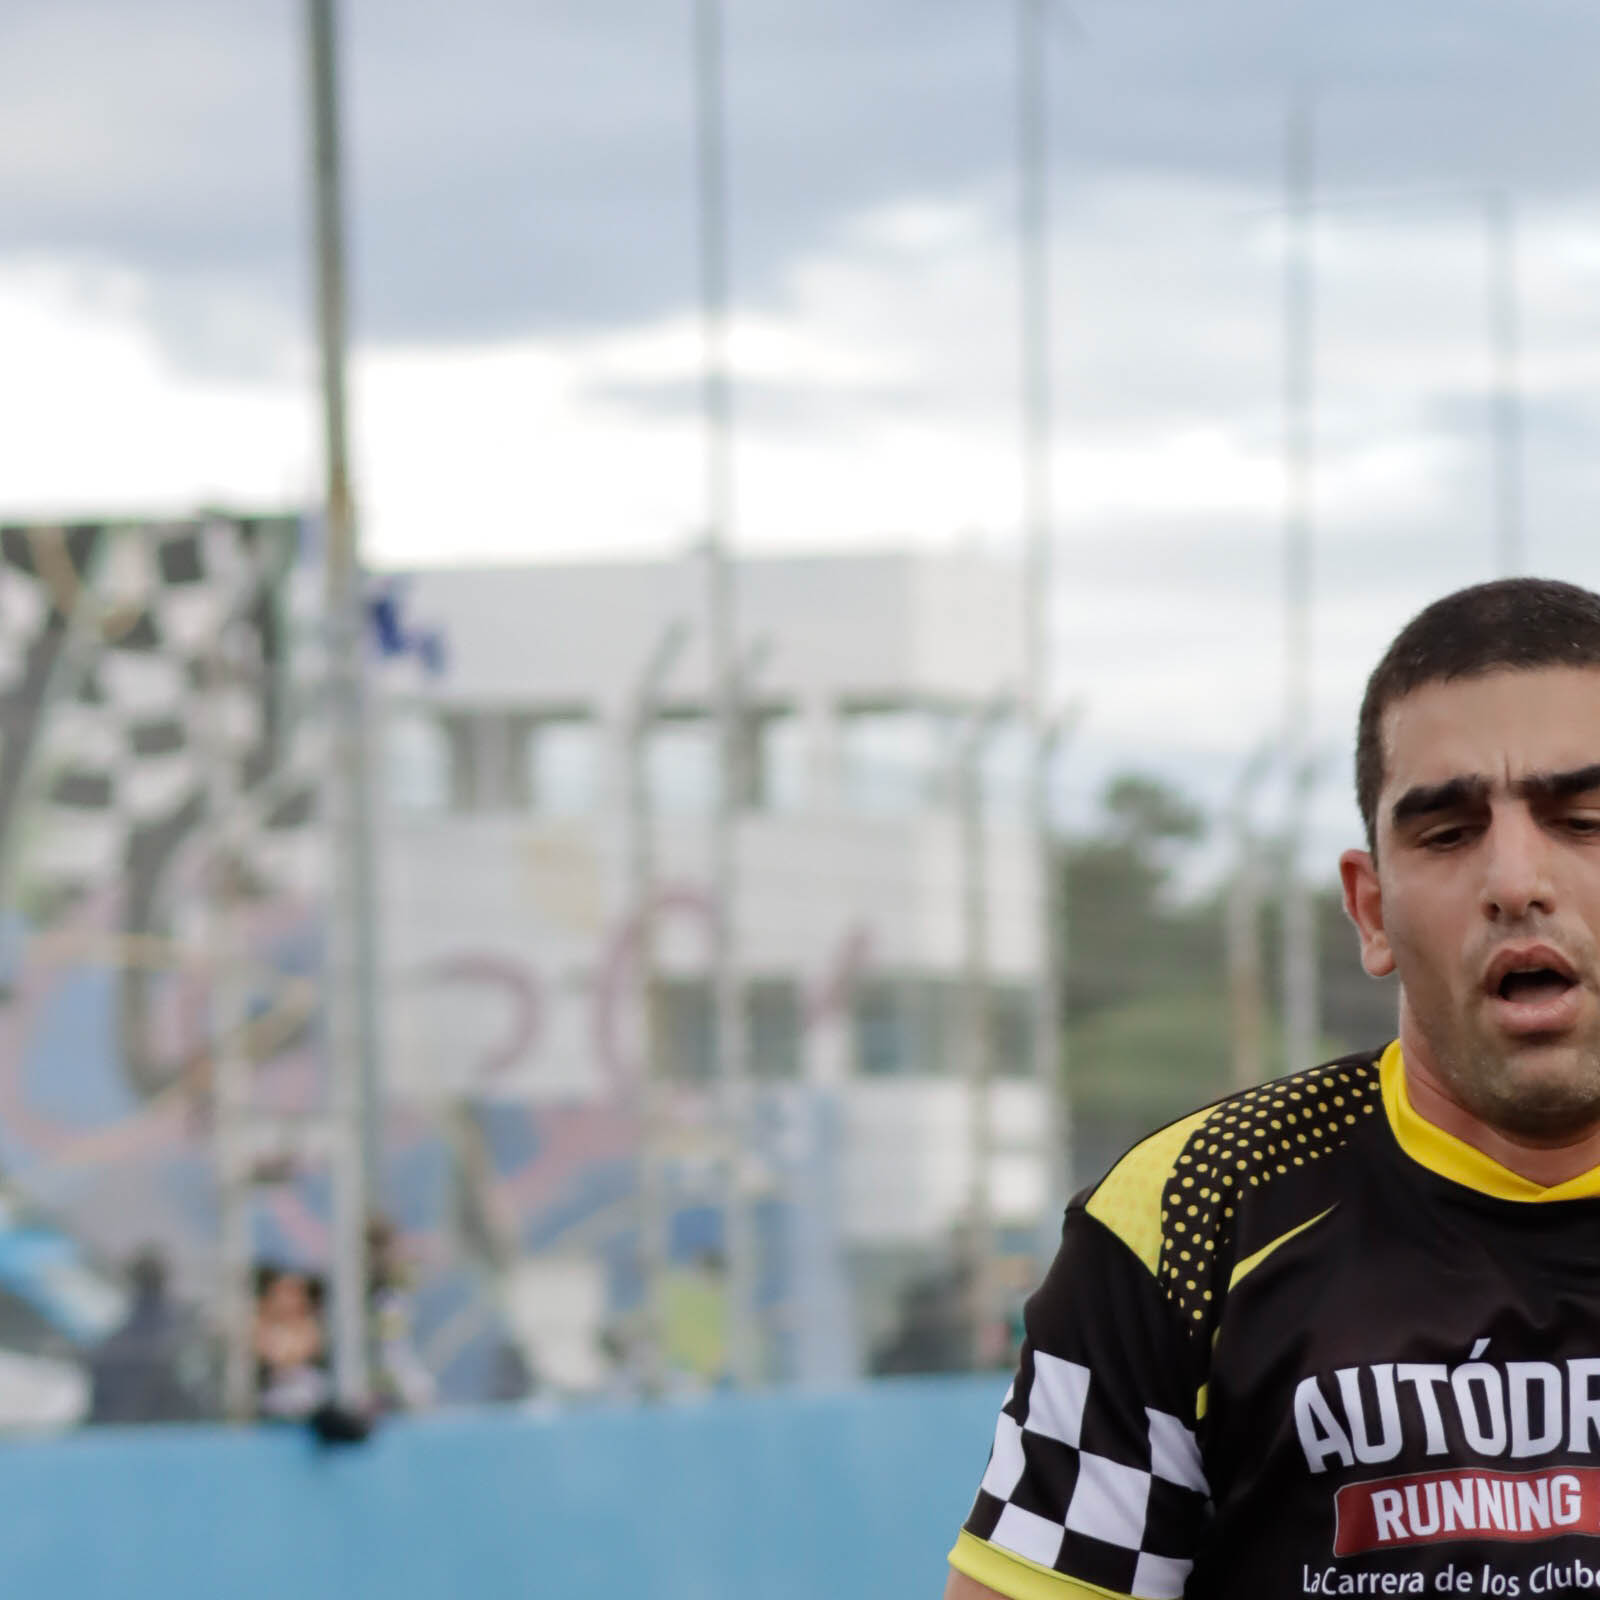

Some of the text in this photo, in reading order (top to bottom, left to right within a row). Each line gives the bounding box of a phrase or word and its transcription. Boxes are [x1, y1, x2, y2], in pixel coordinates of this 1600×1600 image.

[1370, 1475, 1581, 1540] RUNNING
[1435, 1564, 1473, 1593] de
[1482, 1565, 1520, 1597] los
